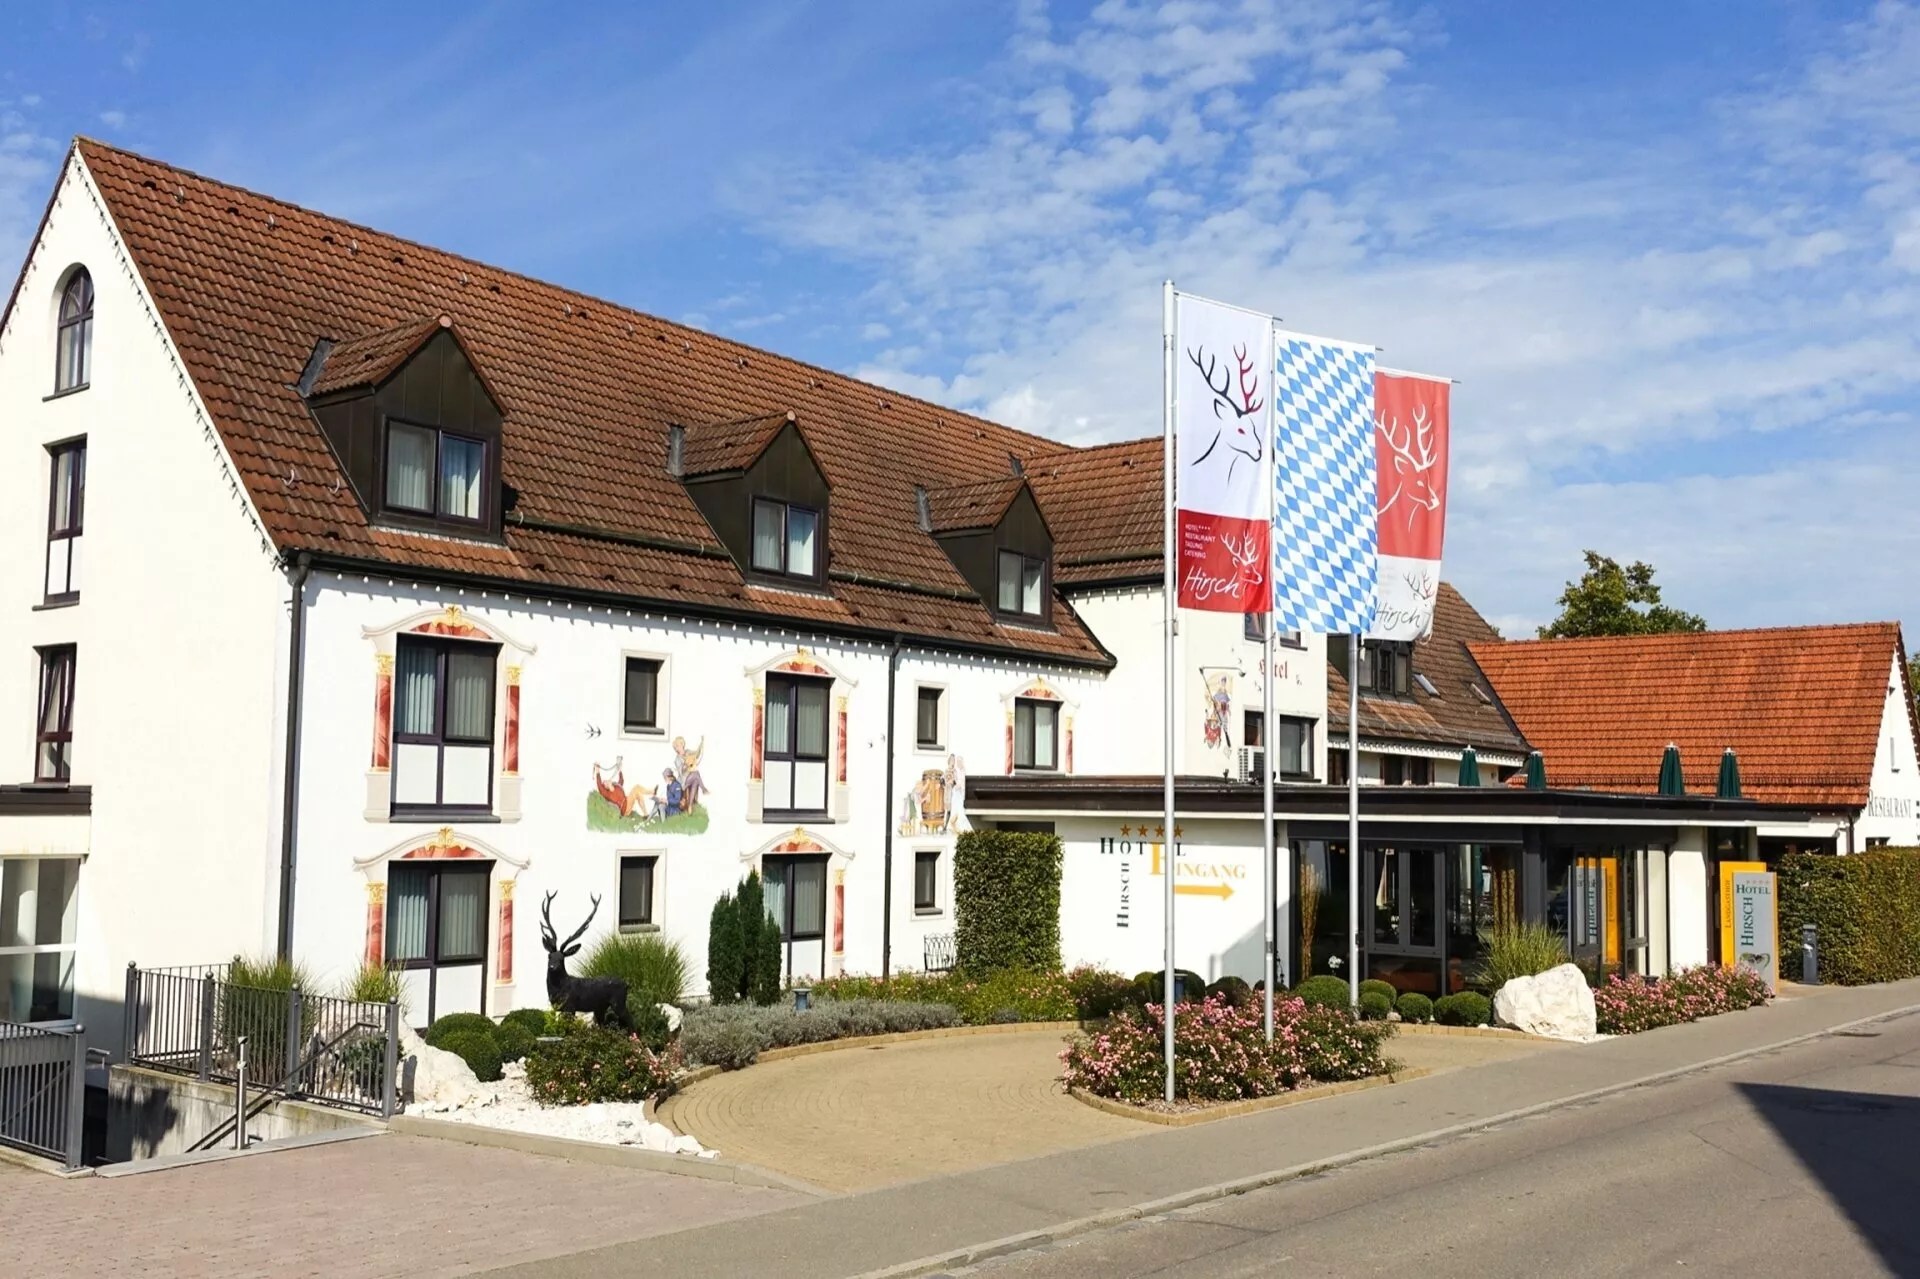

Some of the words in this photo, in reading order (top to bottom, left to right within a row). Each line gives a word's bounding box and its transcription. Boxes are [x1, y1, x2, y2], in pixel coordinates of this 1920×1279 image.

[1184, 531, 1216, 543] RESTAURANT
[1183, 565, 1240, 600] Hirsch
[1376, 601, 1421, 631] Hirsch
[1116, 862, 1130, 928] HIRSCH
[1736, 884, 1771, 895] HOTEL
[1741, 897, 1754, 946] HIRSCH
